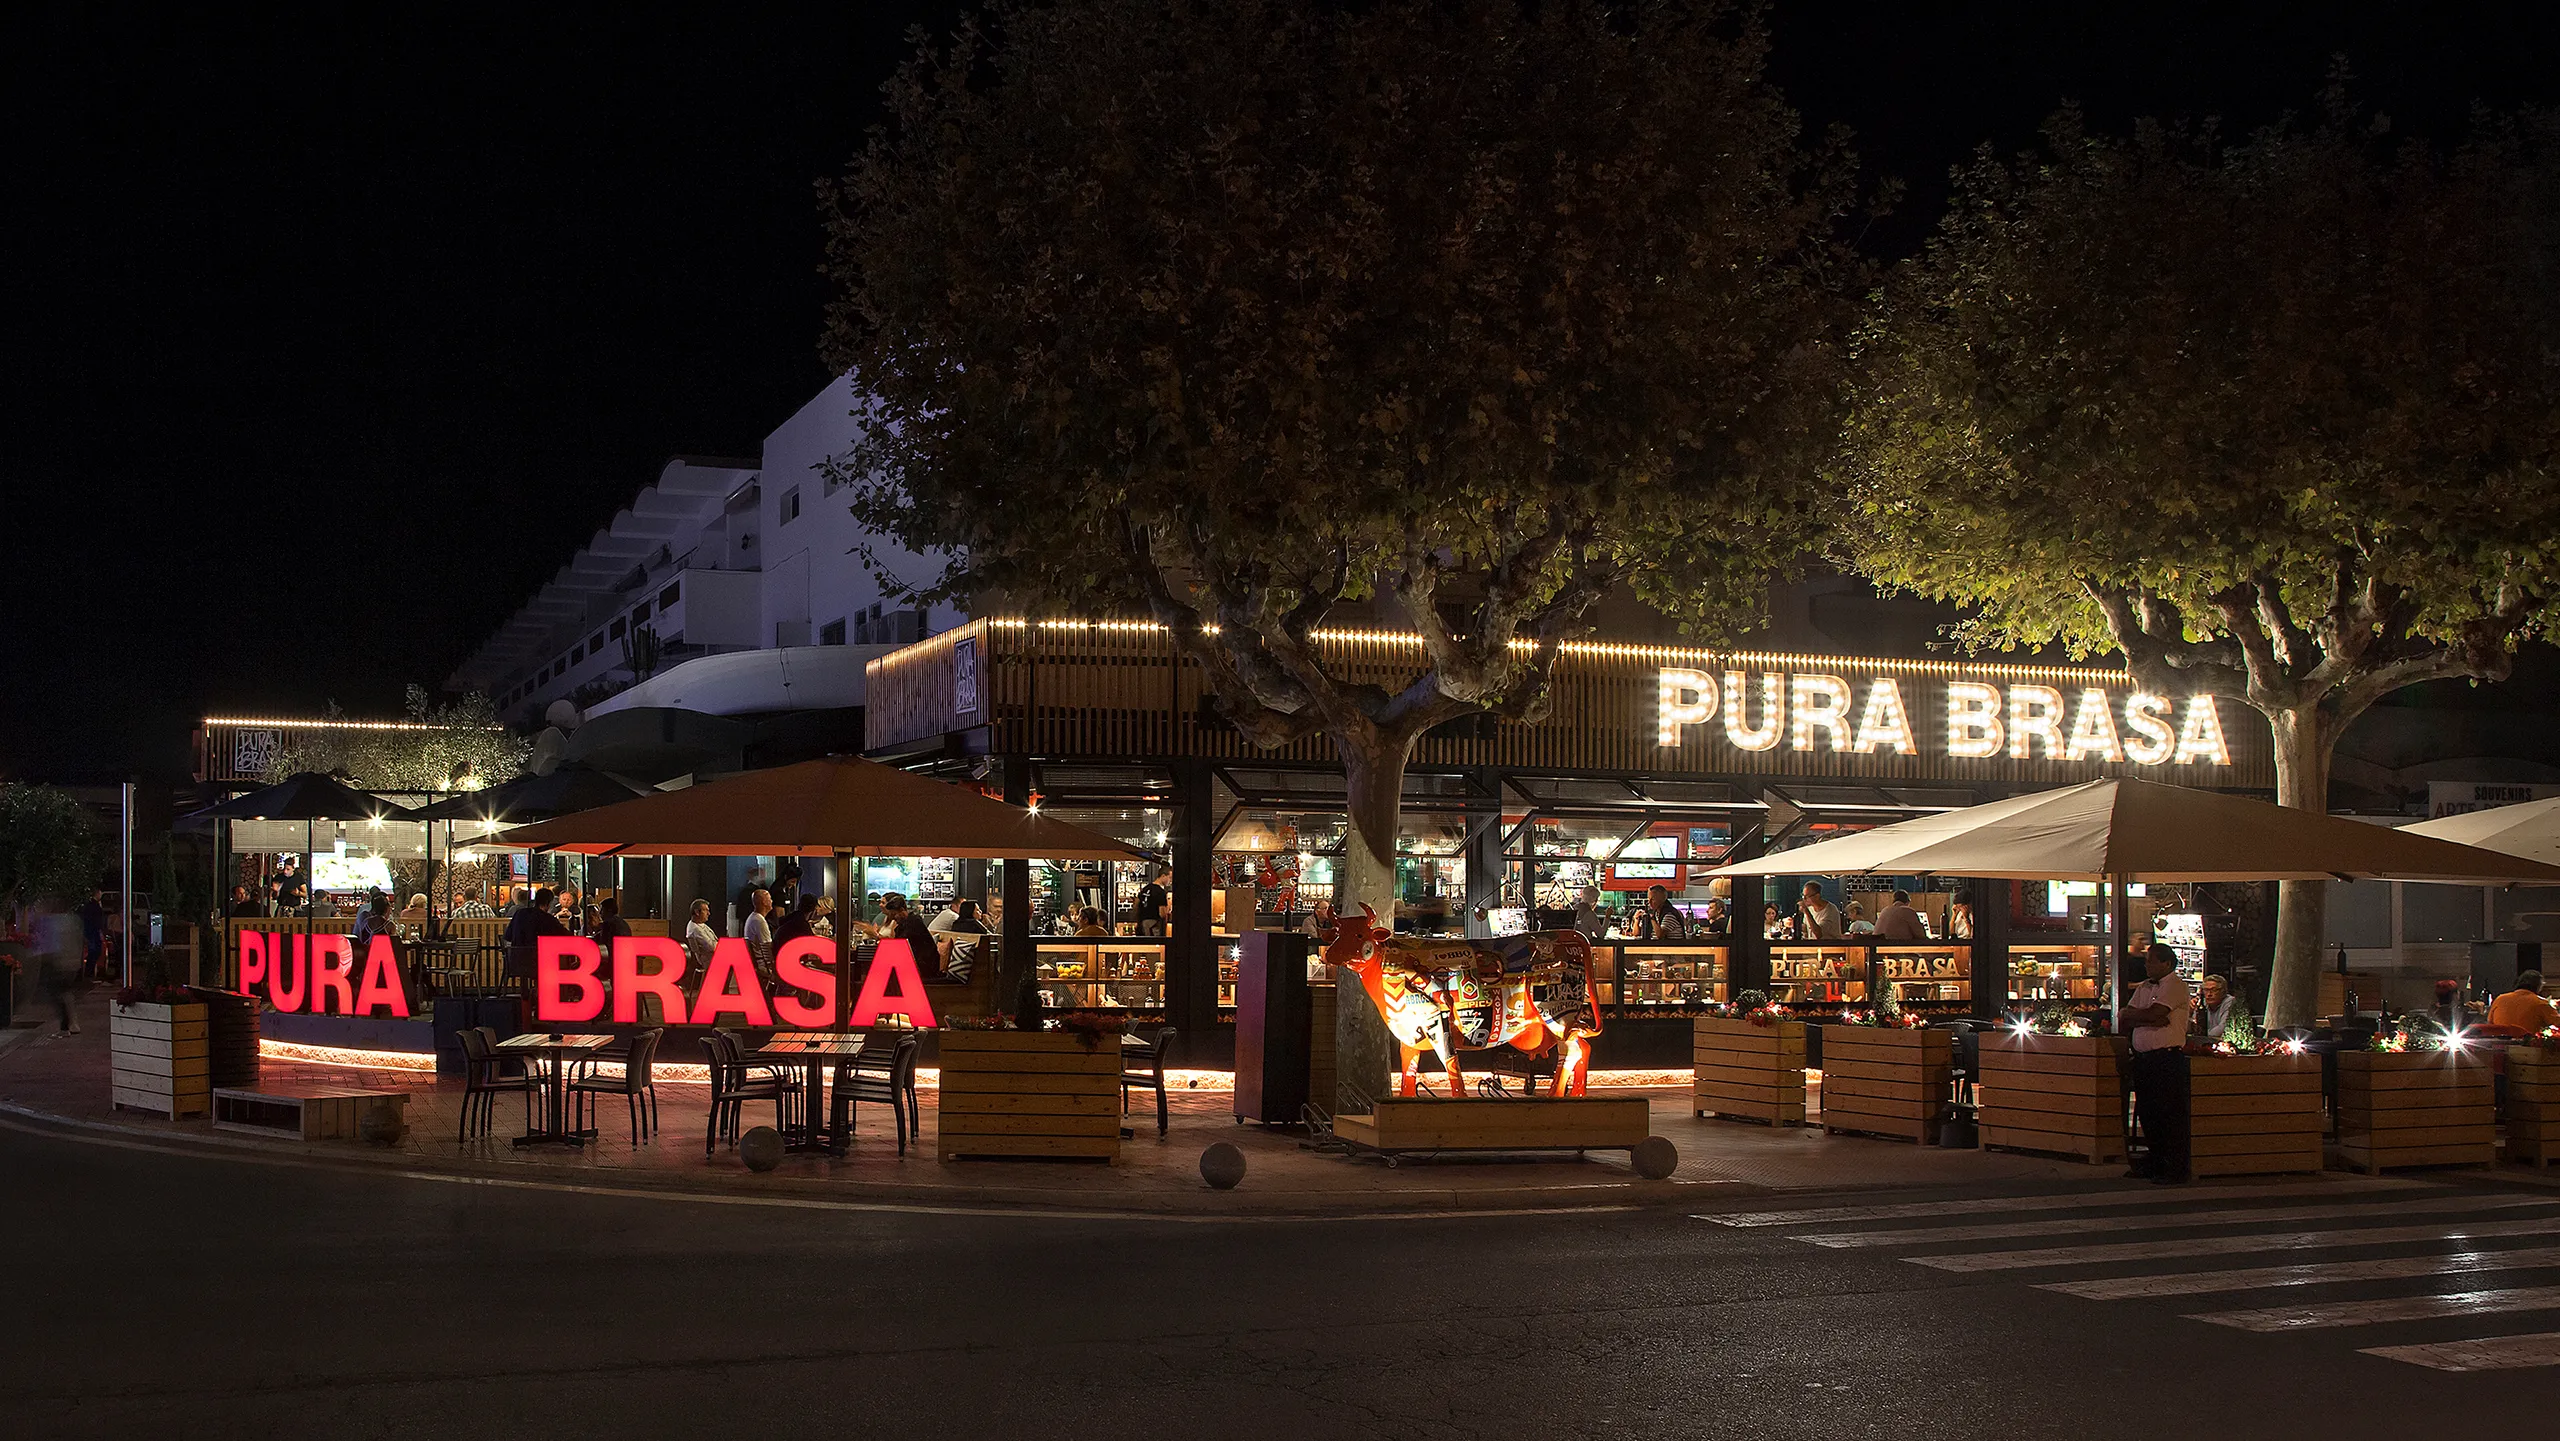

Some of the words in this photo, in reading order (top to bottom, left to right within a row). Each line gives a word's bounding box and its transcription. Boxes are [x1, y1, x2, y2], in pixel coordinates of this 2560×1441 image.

[1658, 666, 1917, 755] PURA
[1947, 681, 2232, 766] BRASA
[2474, 786, 2532, 801] SOUVENIRS
[1447, 949, 1473, 959] BBQ
[239, 929, 410, 1018] PURA
[537, 935, 938, 1028] BRASA
[1771, 957, 1840, 979] PURA
[1883, 957, 1961, 978] BRASA
